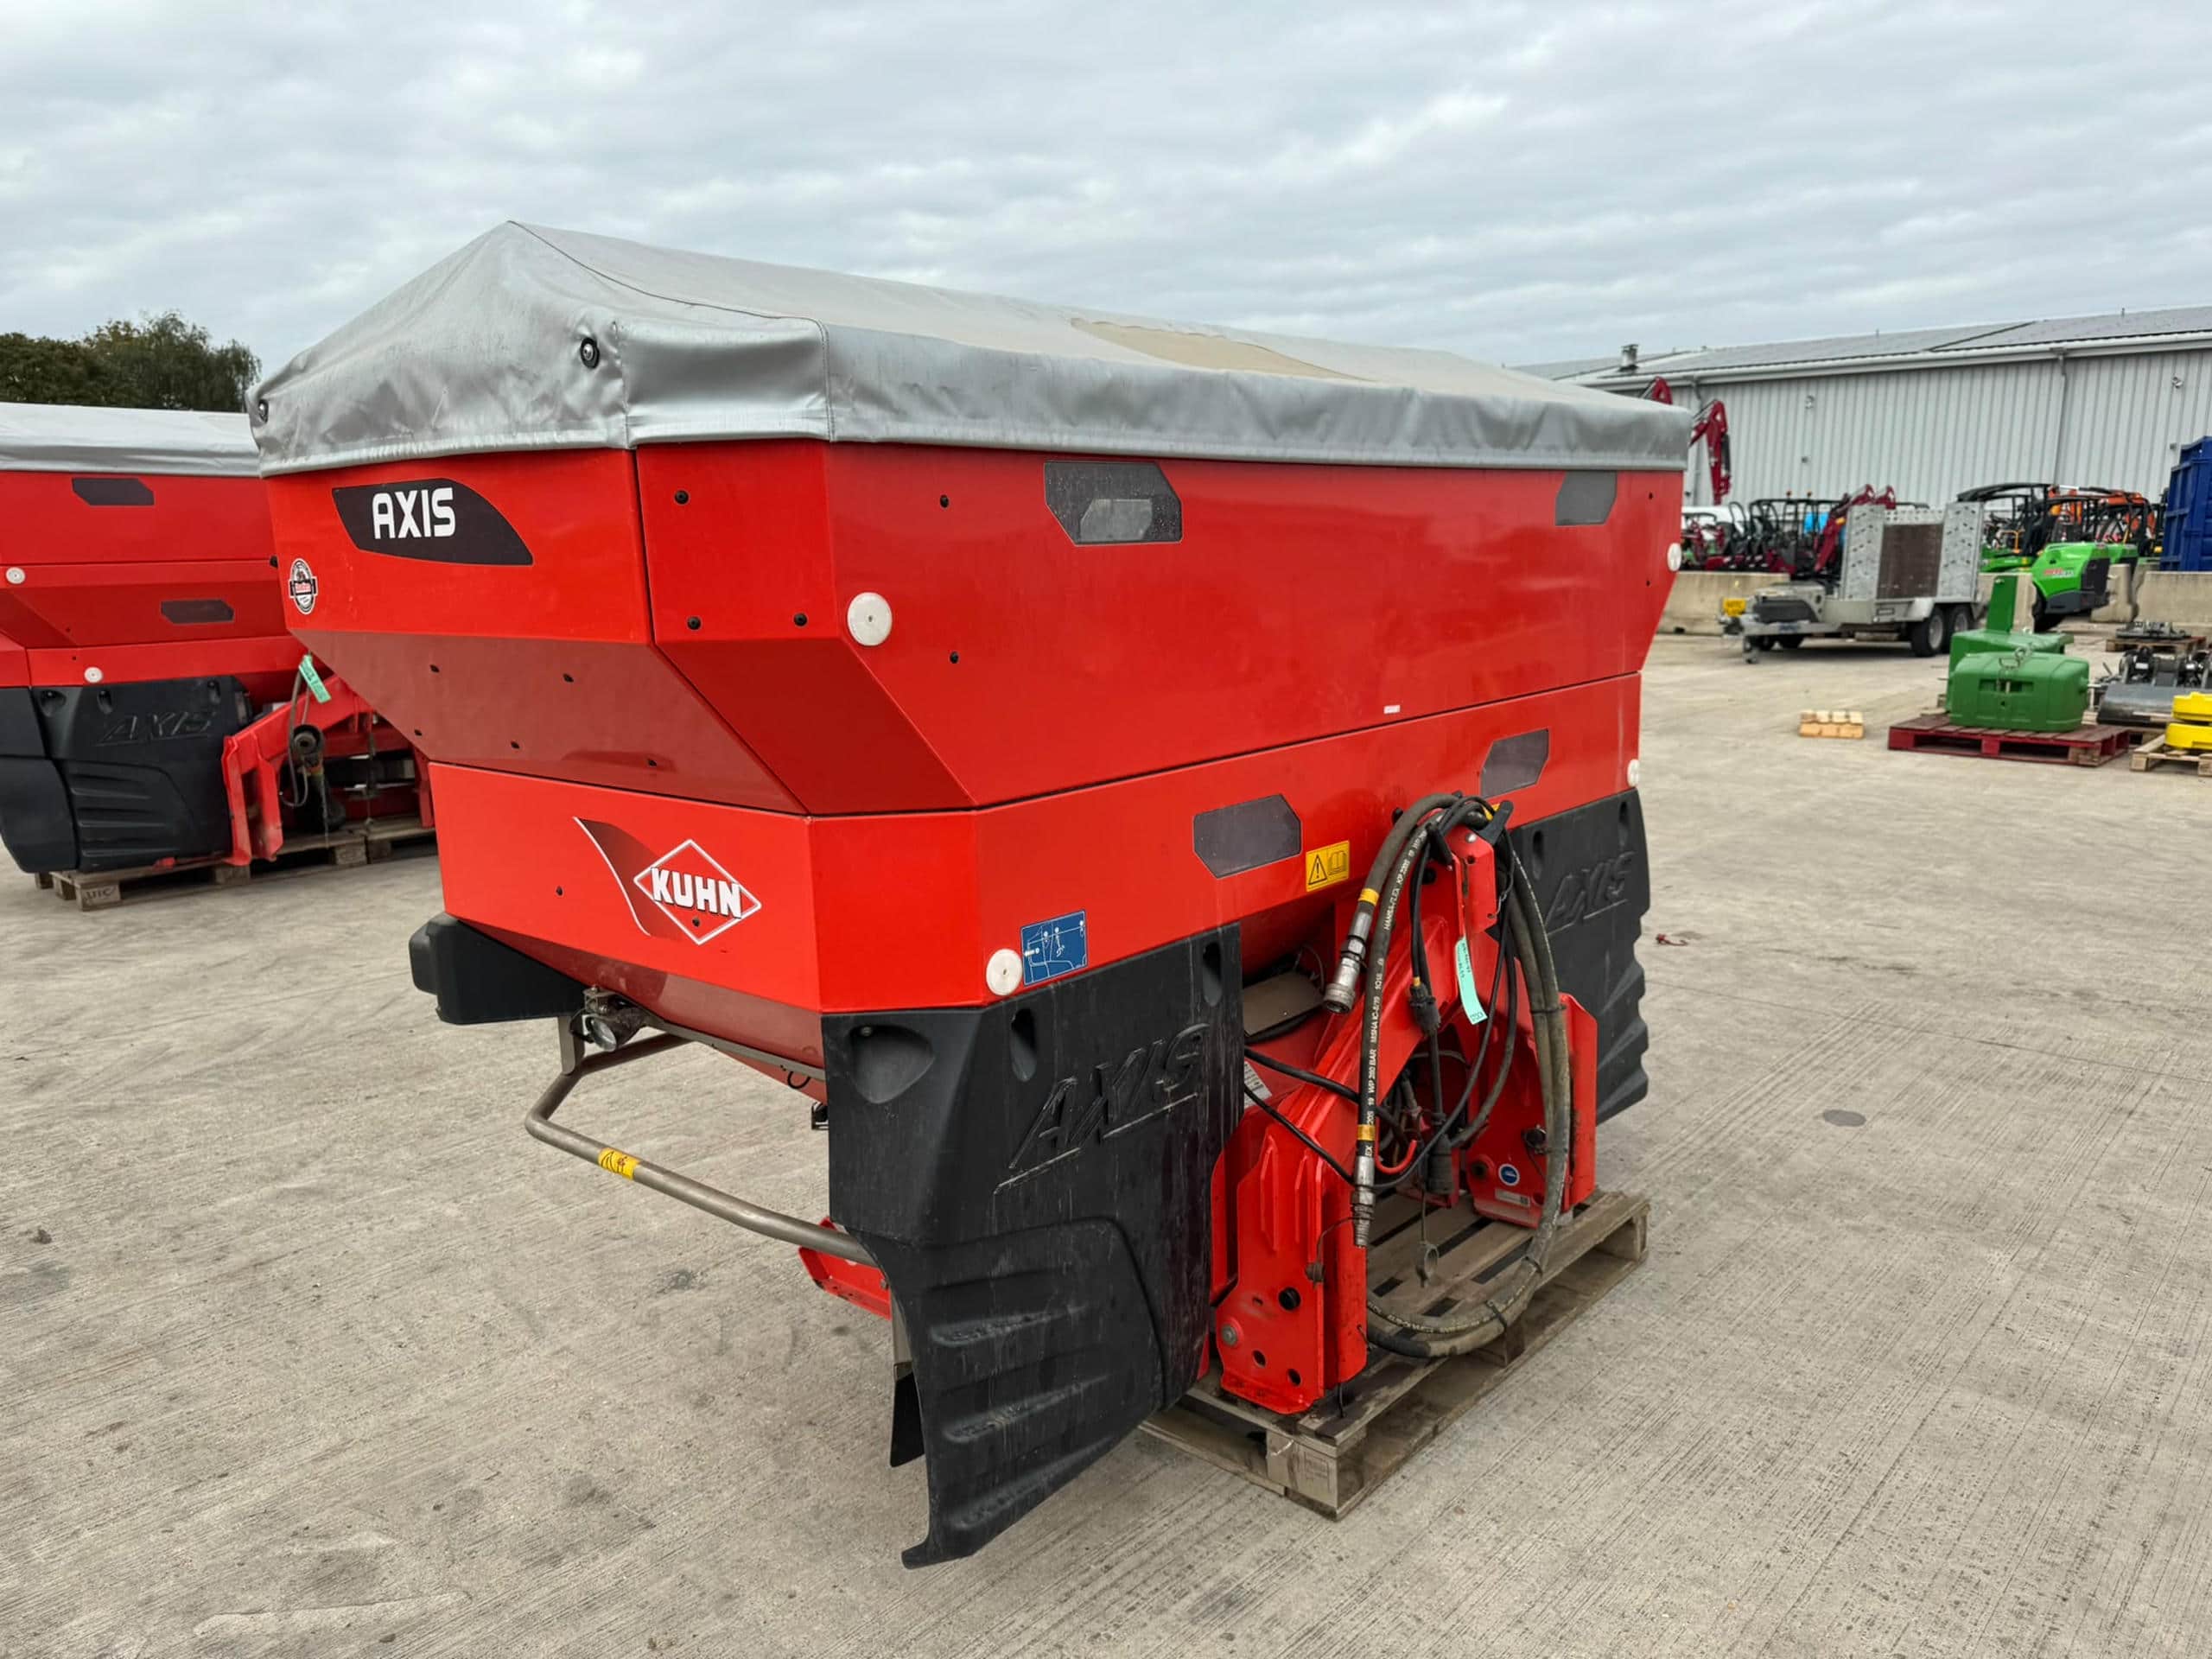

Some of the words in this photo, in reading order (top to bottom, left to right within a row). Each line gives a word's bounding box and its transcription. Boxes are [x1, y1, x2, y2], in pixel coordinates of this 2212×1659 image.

[372, 486, 456, 541] AXIS
[650, 867, 743, 919] KUHN
[1369, 1049, 1377, 1065] BAR
[1007, 1023, 1211, 1171] AXIS
